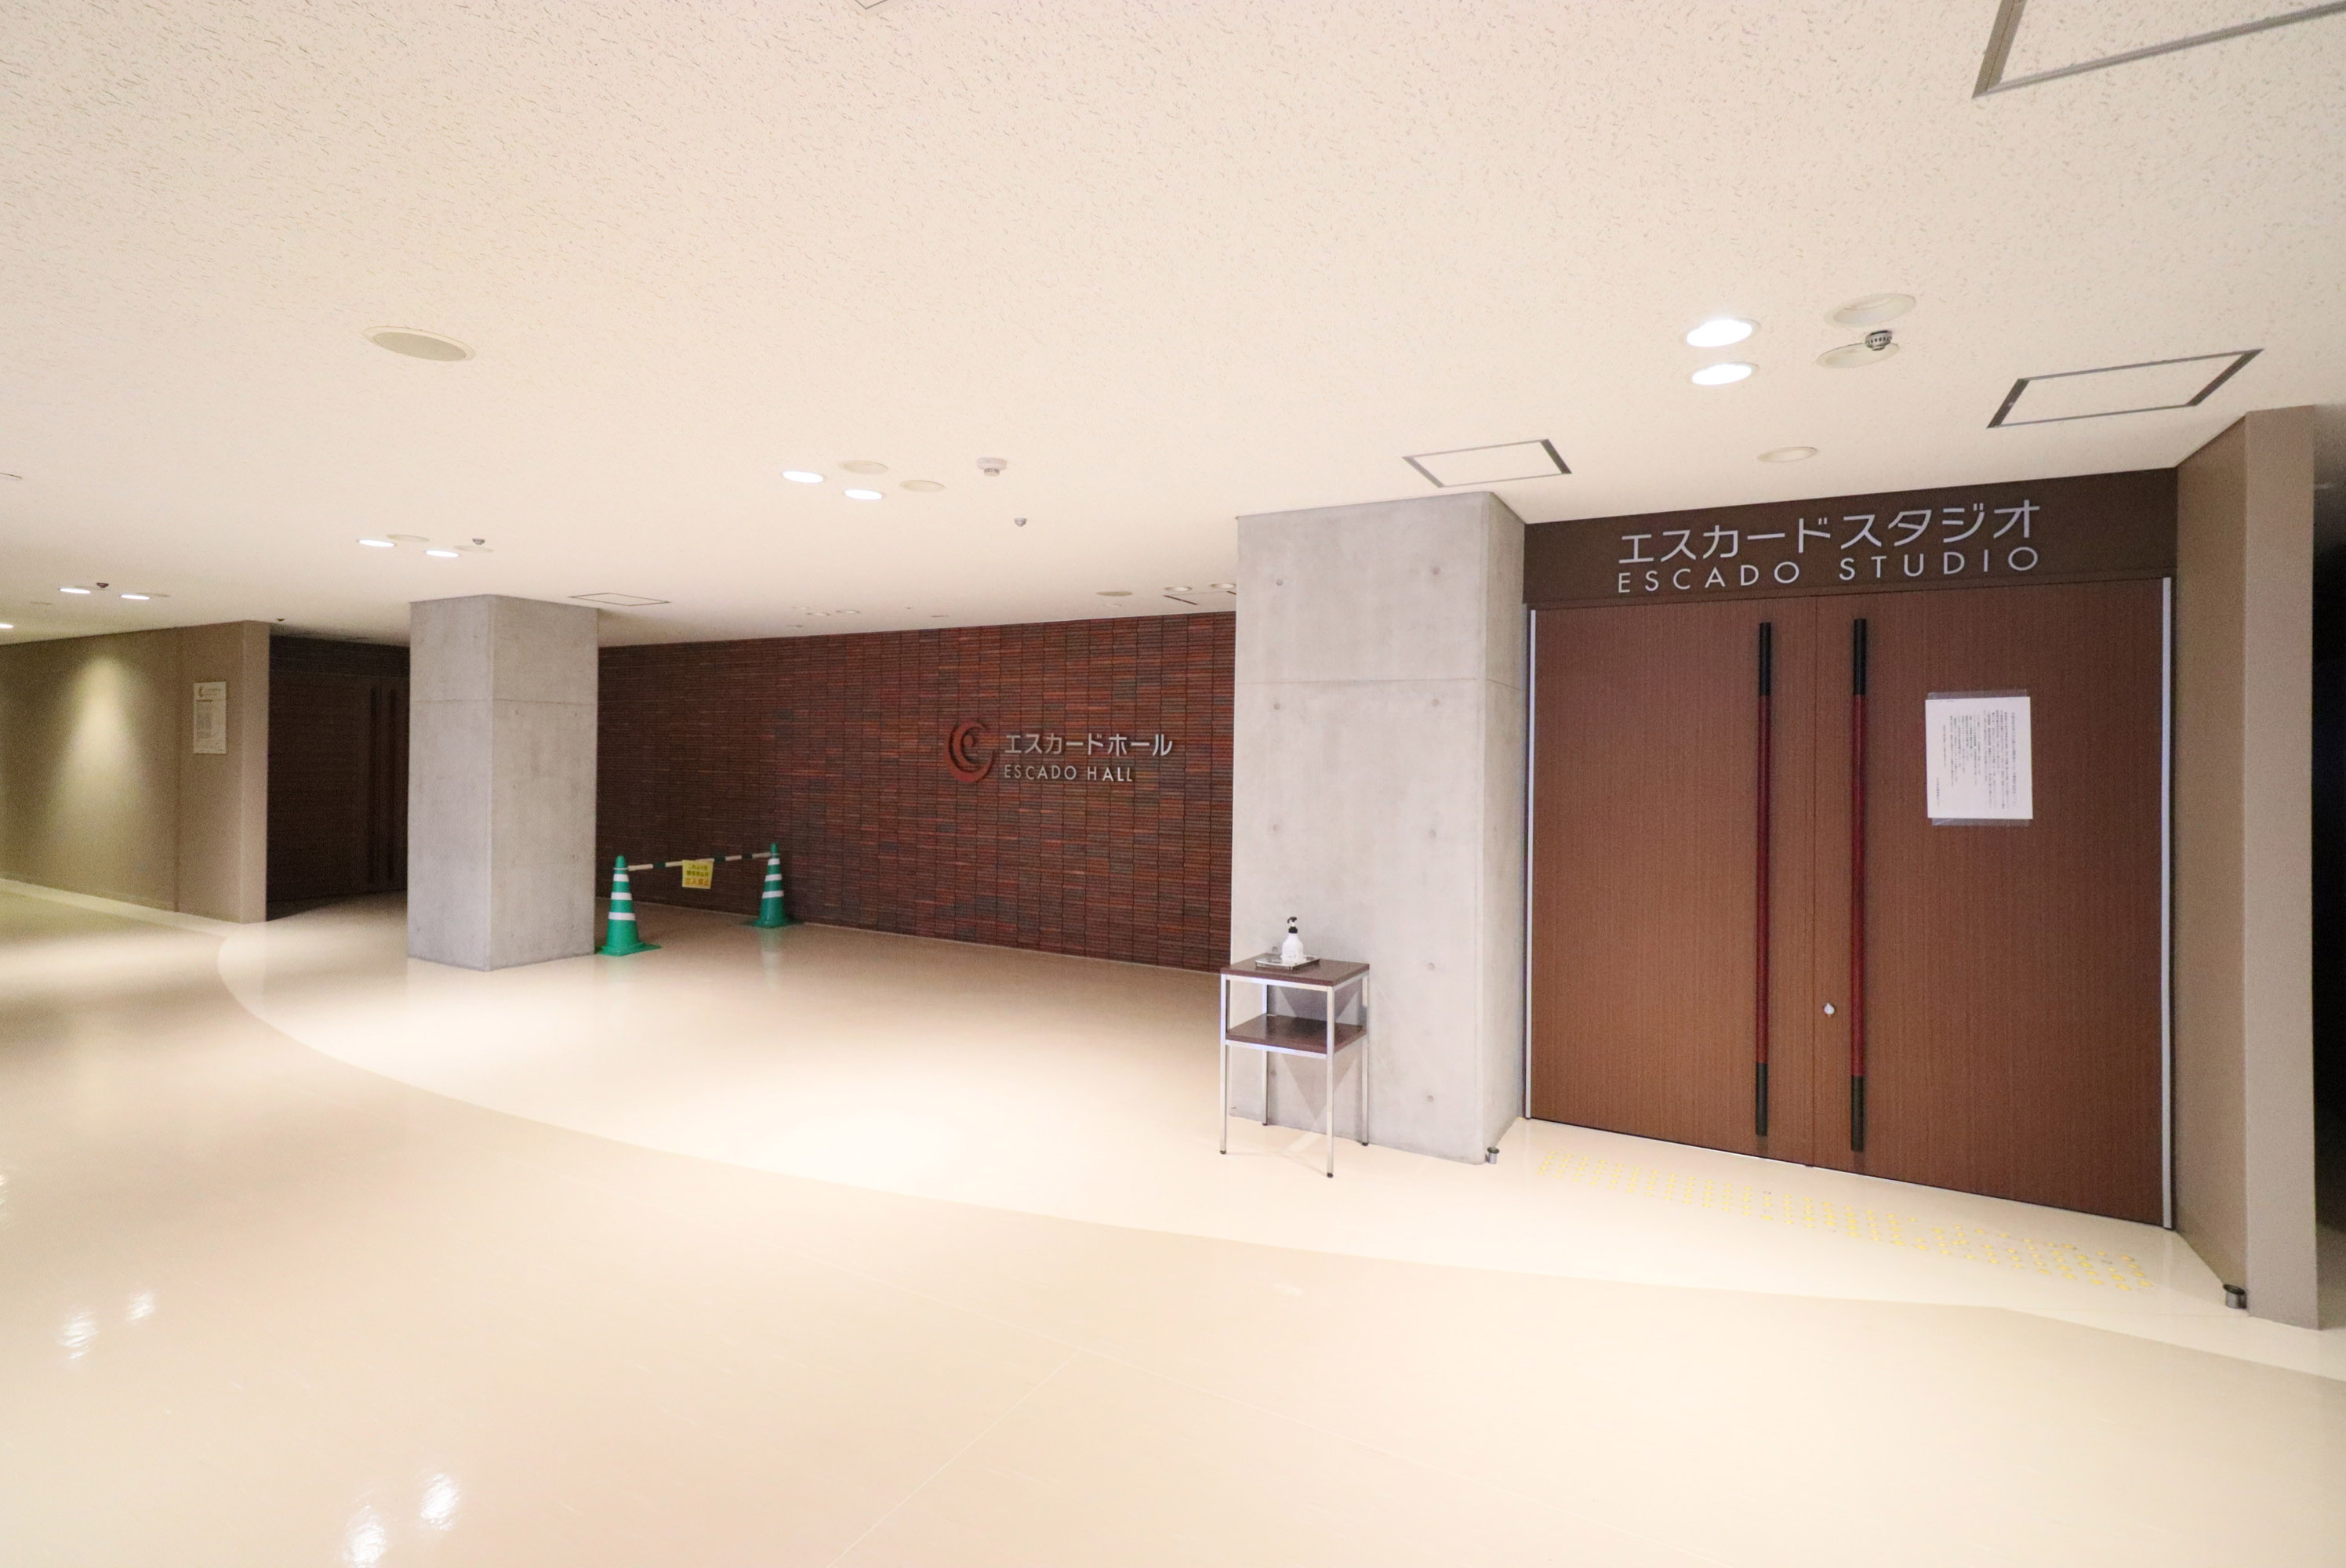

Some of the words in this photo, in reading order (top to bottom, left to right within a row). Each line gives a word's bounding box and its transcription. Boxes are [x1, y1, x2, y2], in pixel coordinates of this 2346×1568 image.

[1619, 499, 2039, 564] エスカードスタジオ
[1618, 561, 1799, 593] ESCADO
[1839, 546, 2039, 580] STUDIO
[1005, 733, 1172, 757] エスカードホール
[1004, 764, 1077, 780] ESCADO
[1088, 767, 1132, 782] HALL
